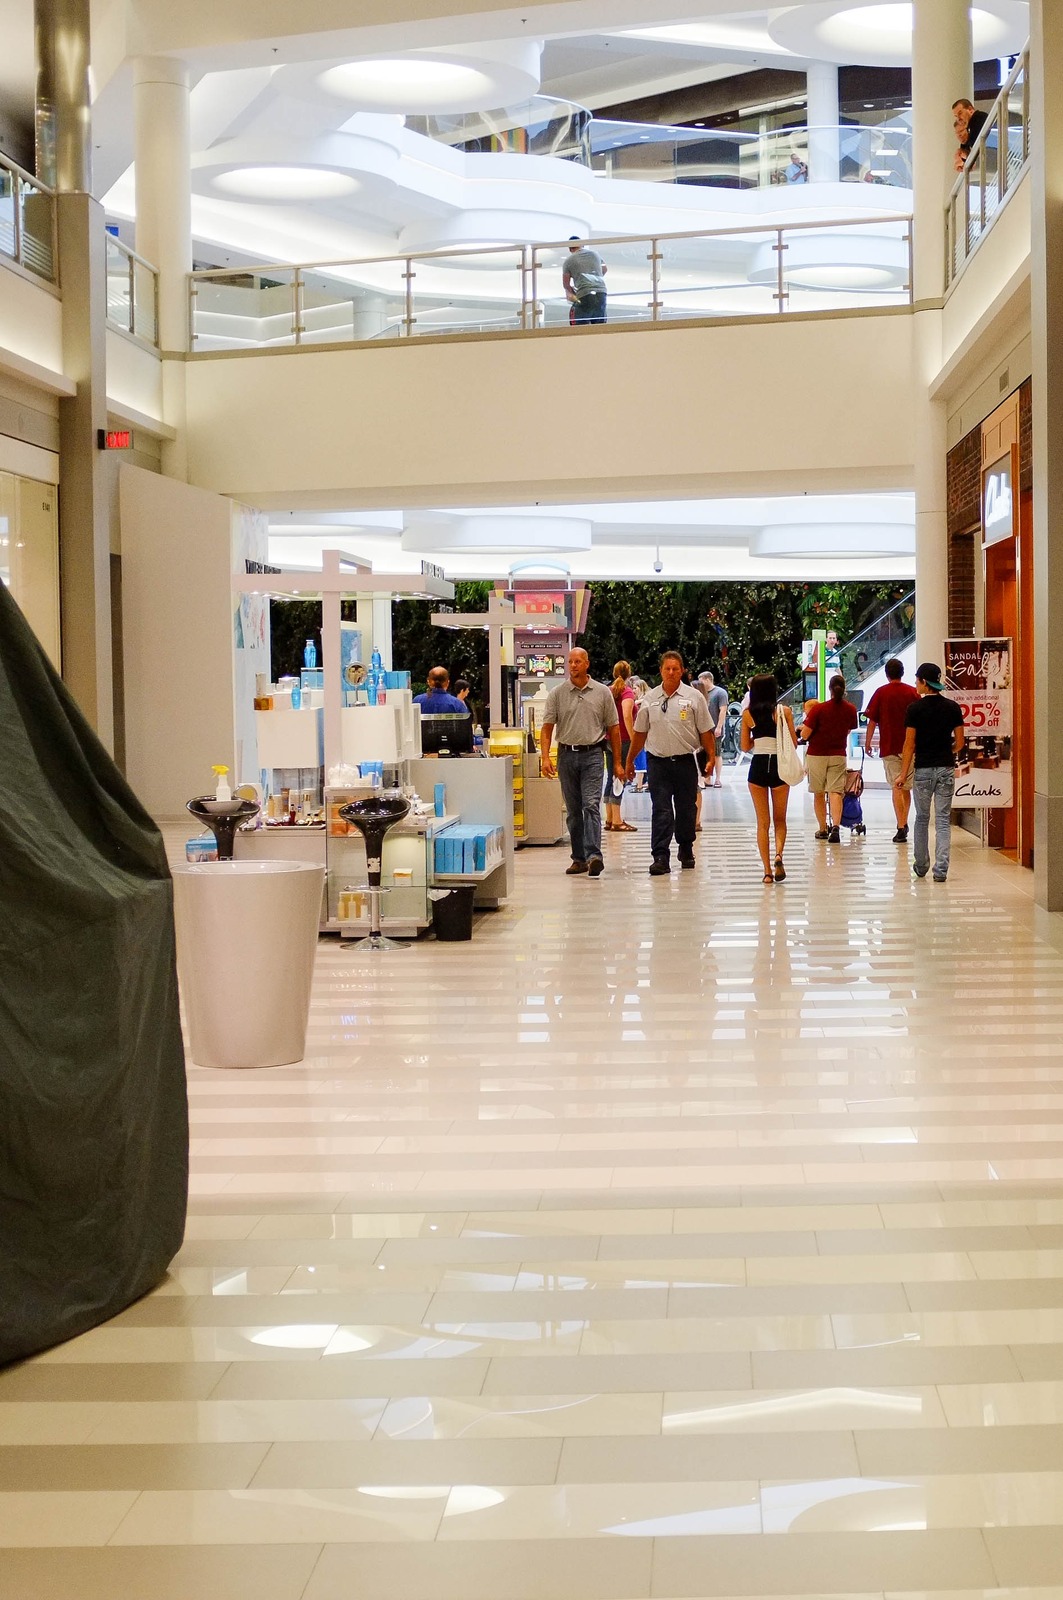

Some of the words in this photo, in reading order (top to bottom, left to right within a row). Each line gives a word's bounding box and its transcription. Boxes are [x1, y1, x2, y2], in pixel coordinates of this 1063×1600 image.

[107, 431, 129, 448] EXIT
[949, 652, 981, 660] SANDAL
[987, 717, 999, 727] off
[955, 783, 1001, 796] Clarks
